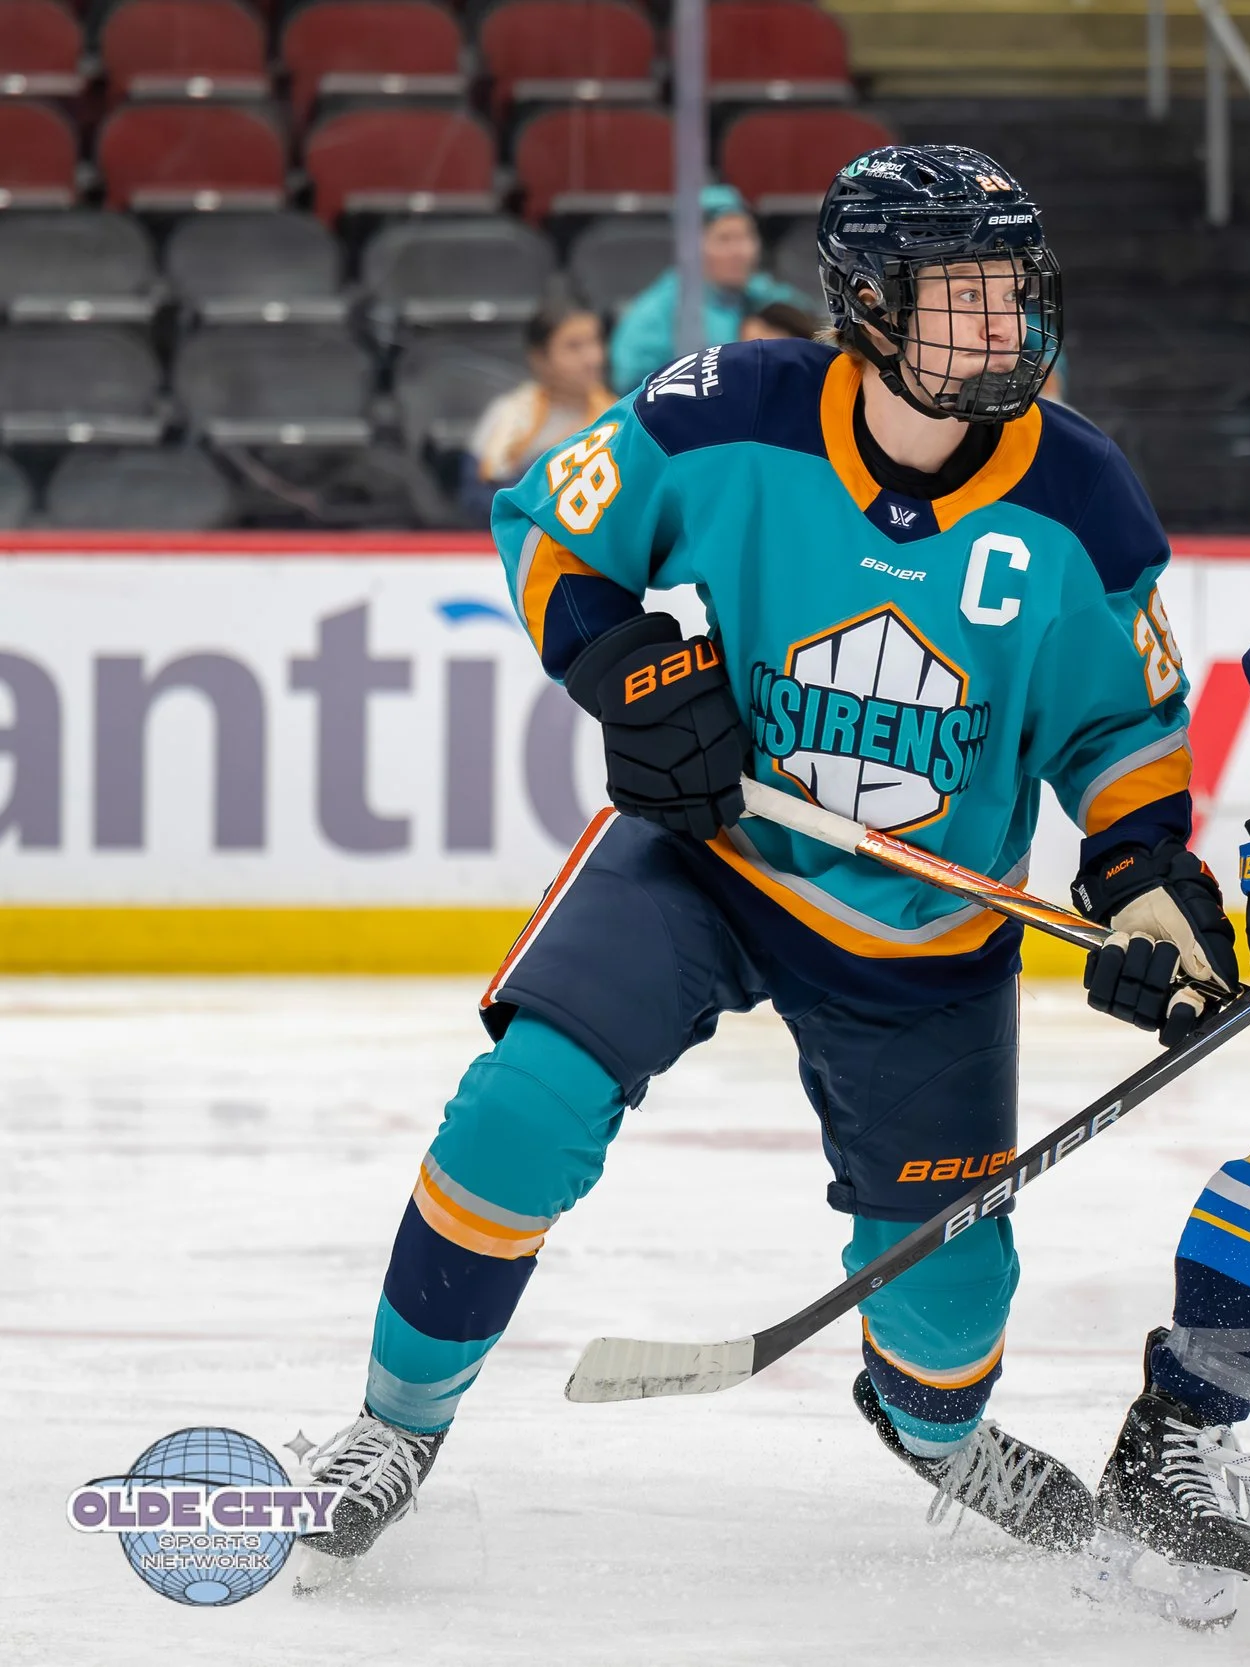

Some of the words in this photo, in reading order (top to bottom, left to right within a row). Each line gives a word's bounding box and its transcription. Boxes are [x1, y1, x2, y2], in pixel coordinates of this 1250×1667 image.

[988, 214, 1033, 225] BAUER
[701, 345, 722, 396] PWHL
[546, 423, 622, 535] 28
[860, 556, 927, 582] BAUER
[960, 532, 1031, 626] C
[768, 677, 972, 796] SIRENS
[1105, 857, 1135, 880] MACH
[944, 1099, 1123, 1244] BAUER
